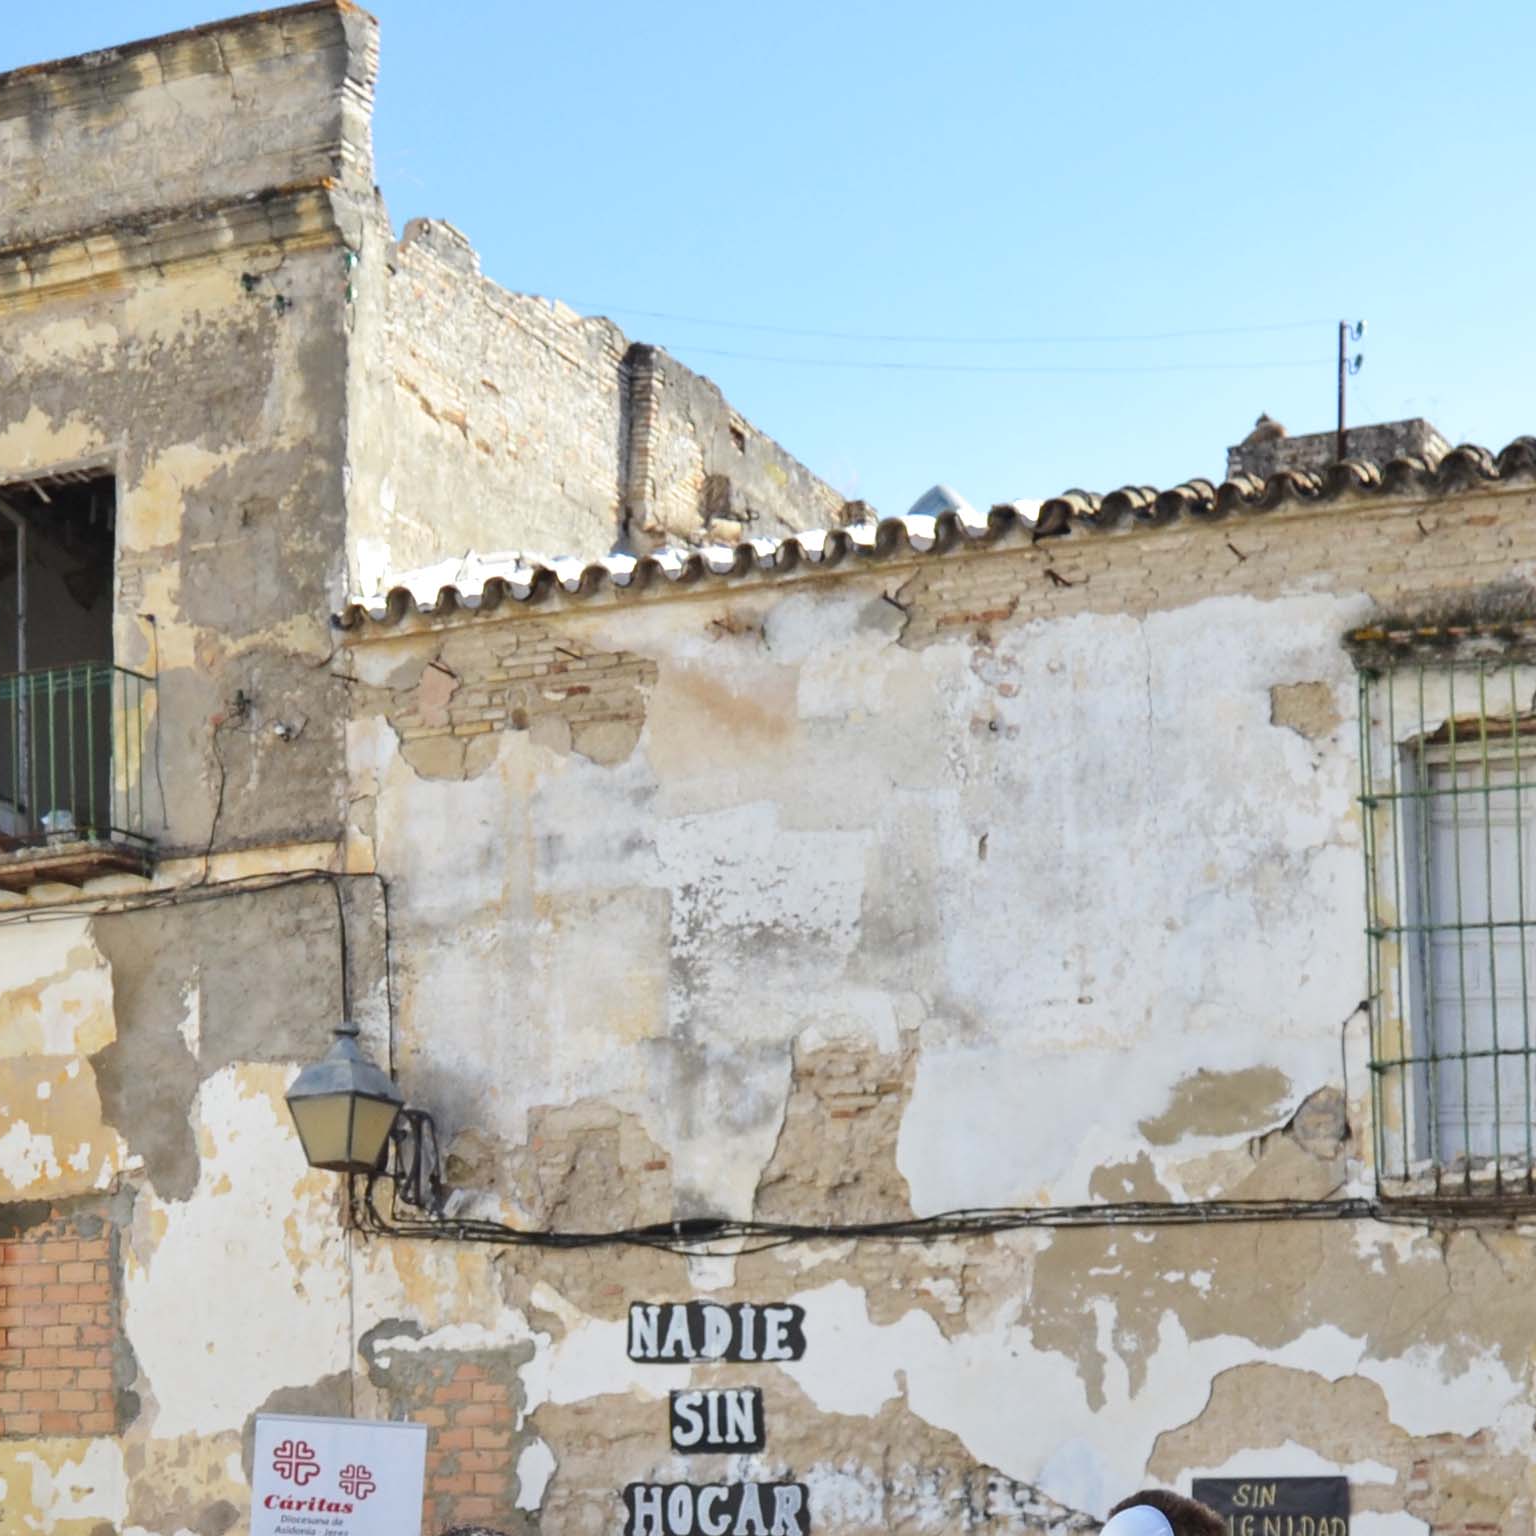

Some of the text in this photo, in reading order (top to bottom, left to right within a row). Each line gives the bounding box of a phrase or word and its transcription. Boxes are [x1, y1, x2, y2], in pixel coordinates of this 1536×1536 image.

[630, 1304, 794, 1360] NADIE
[671, 1390, 757, 1446] SIN
[264, 1493, 353, 1513] Cáritas
[1231, 1483, 1277, 1509] SIN
